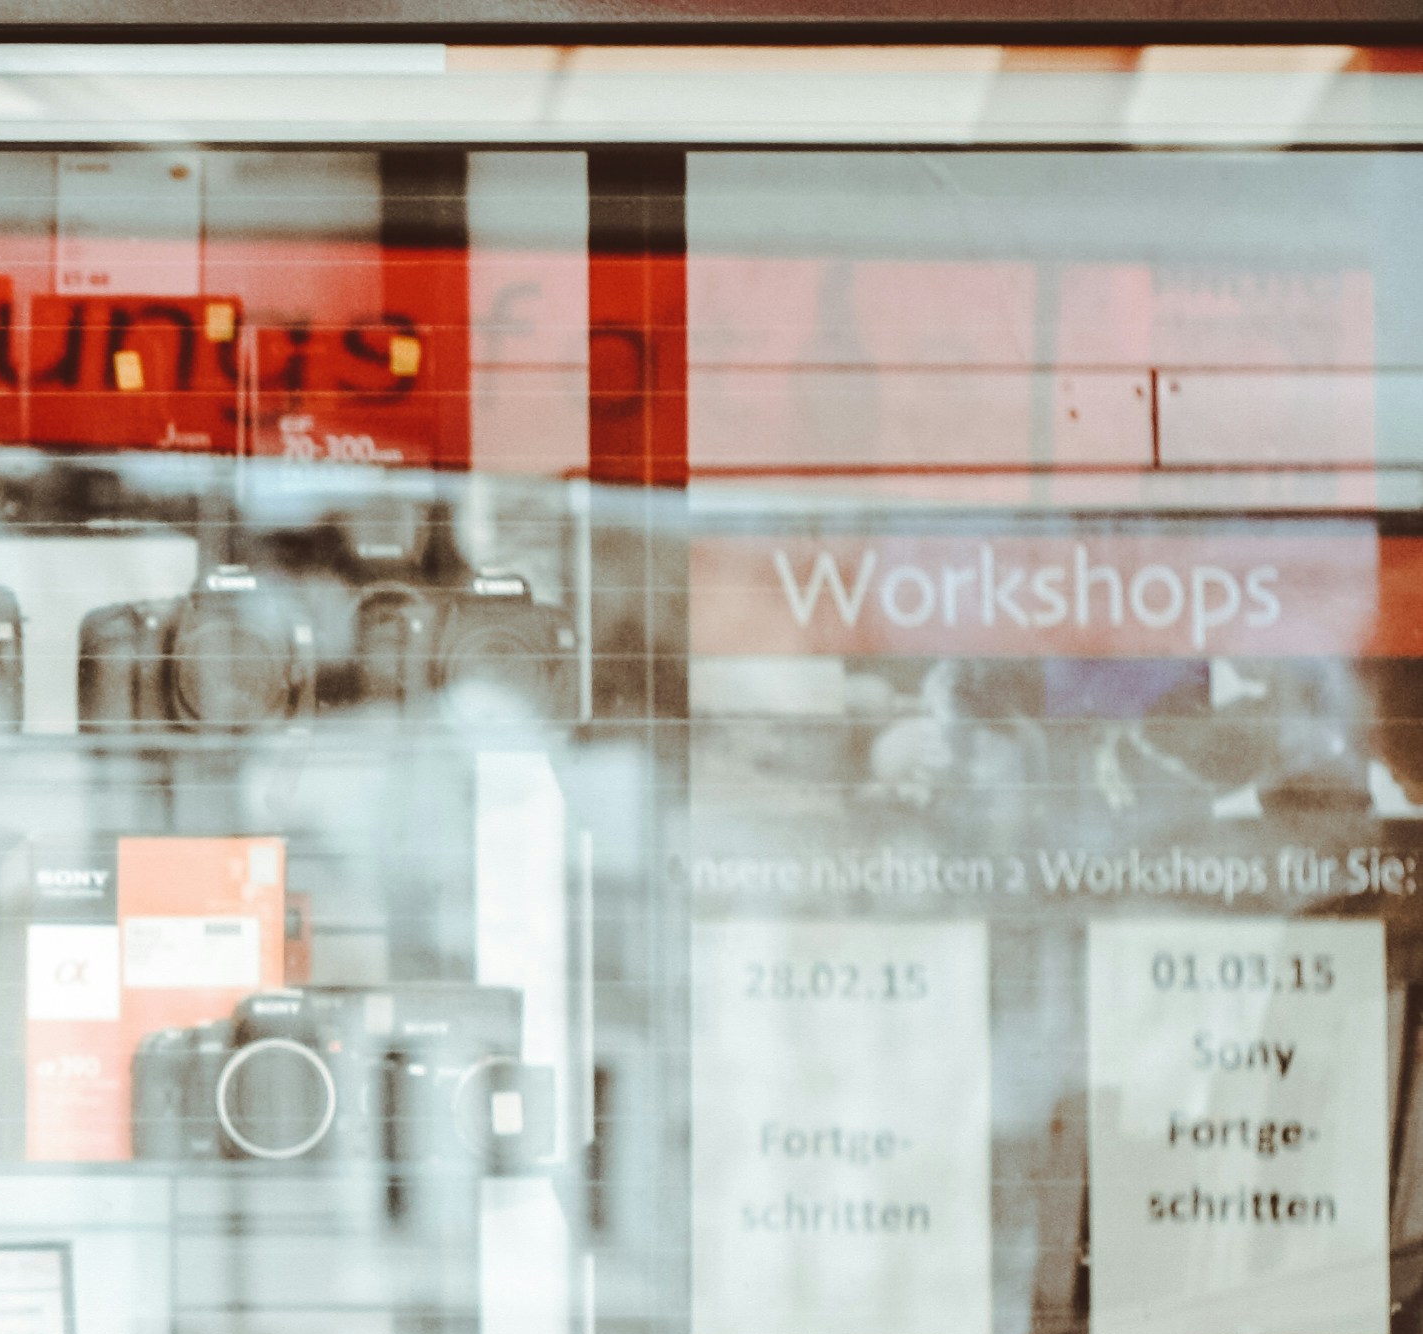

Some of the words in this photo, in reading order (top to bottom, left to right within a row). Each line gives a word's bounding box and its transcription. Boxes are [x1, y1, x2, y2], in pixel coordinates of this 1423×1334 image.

[773, 541, 1283, 651] Workshops
[35, 869, 110, 887] SONY
[1037, 848, 1267, 902] Workshops
[743, 963, 929, 1002] 28.02.15
[252, 1001, 301, 1016] SONY
[1189, 1032, 1298, 1079] Sony
[761, 1119, 914, 1165] Fortge-
[1168, 1110, 1320, 1157] Fortge-
[740, 1193, 932, 1235] schritten
[1147, 1183, 1338, 1224] schritten
